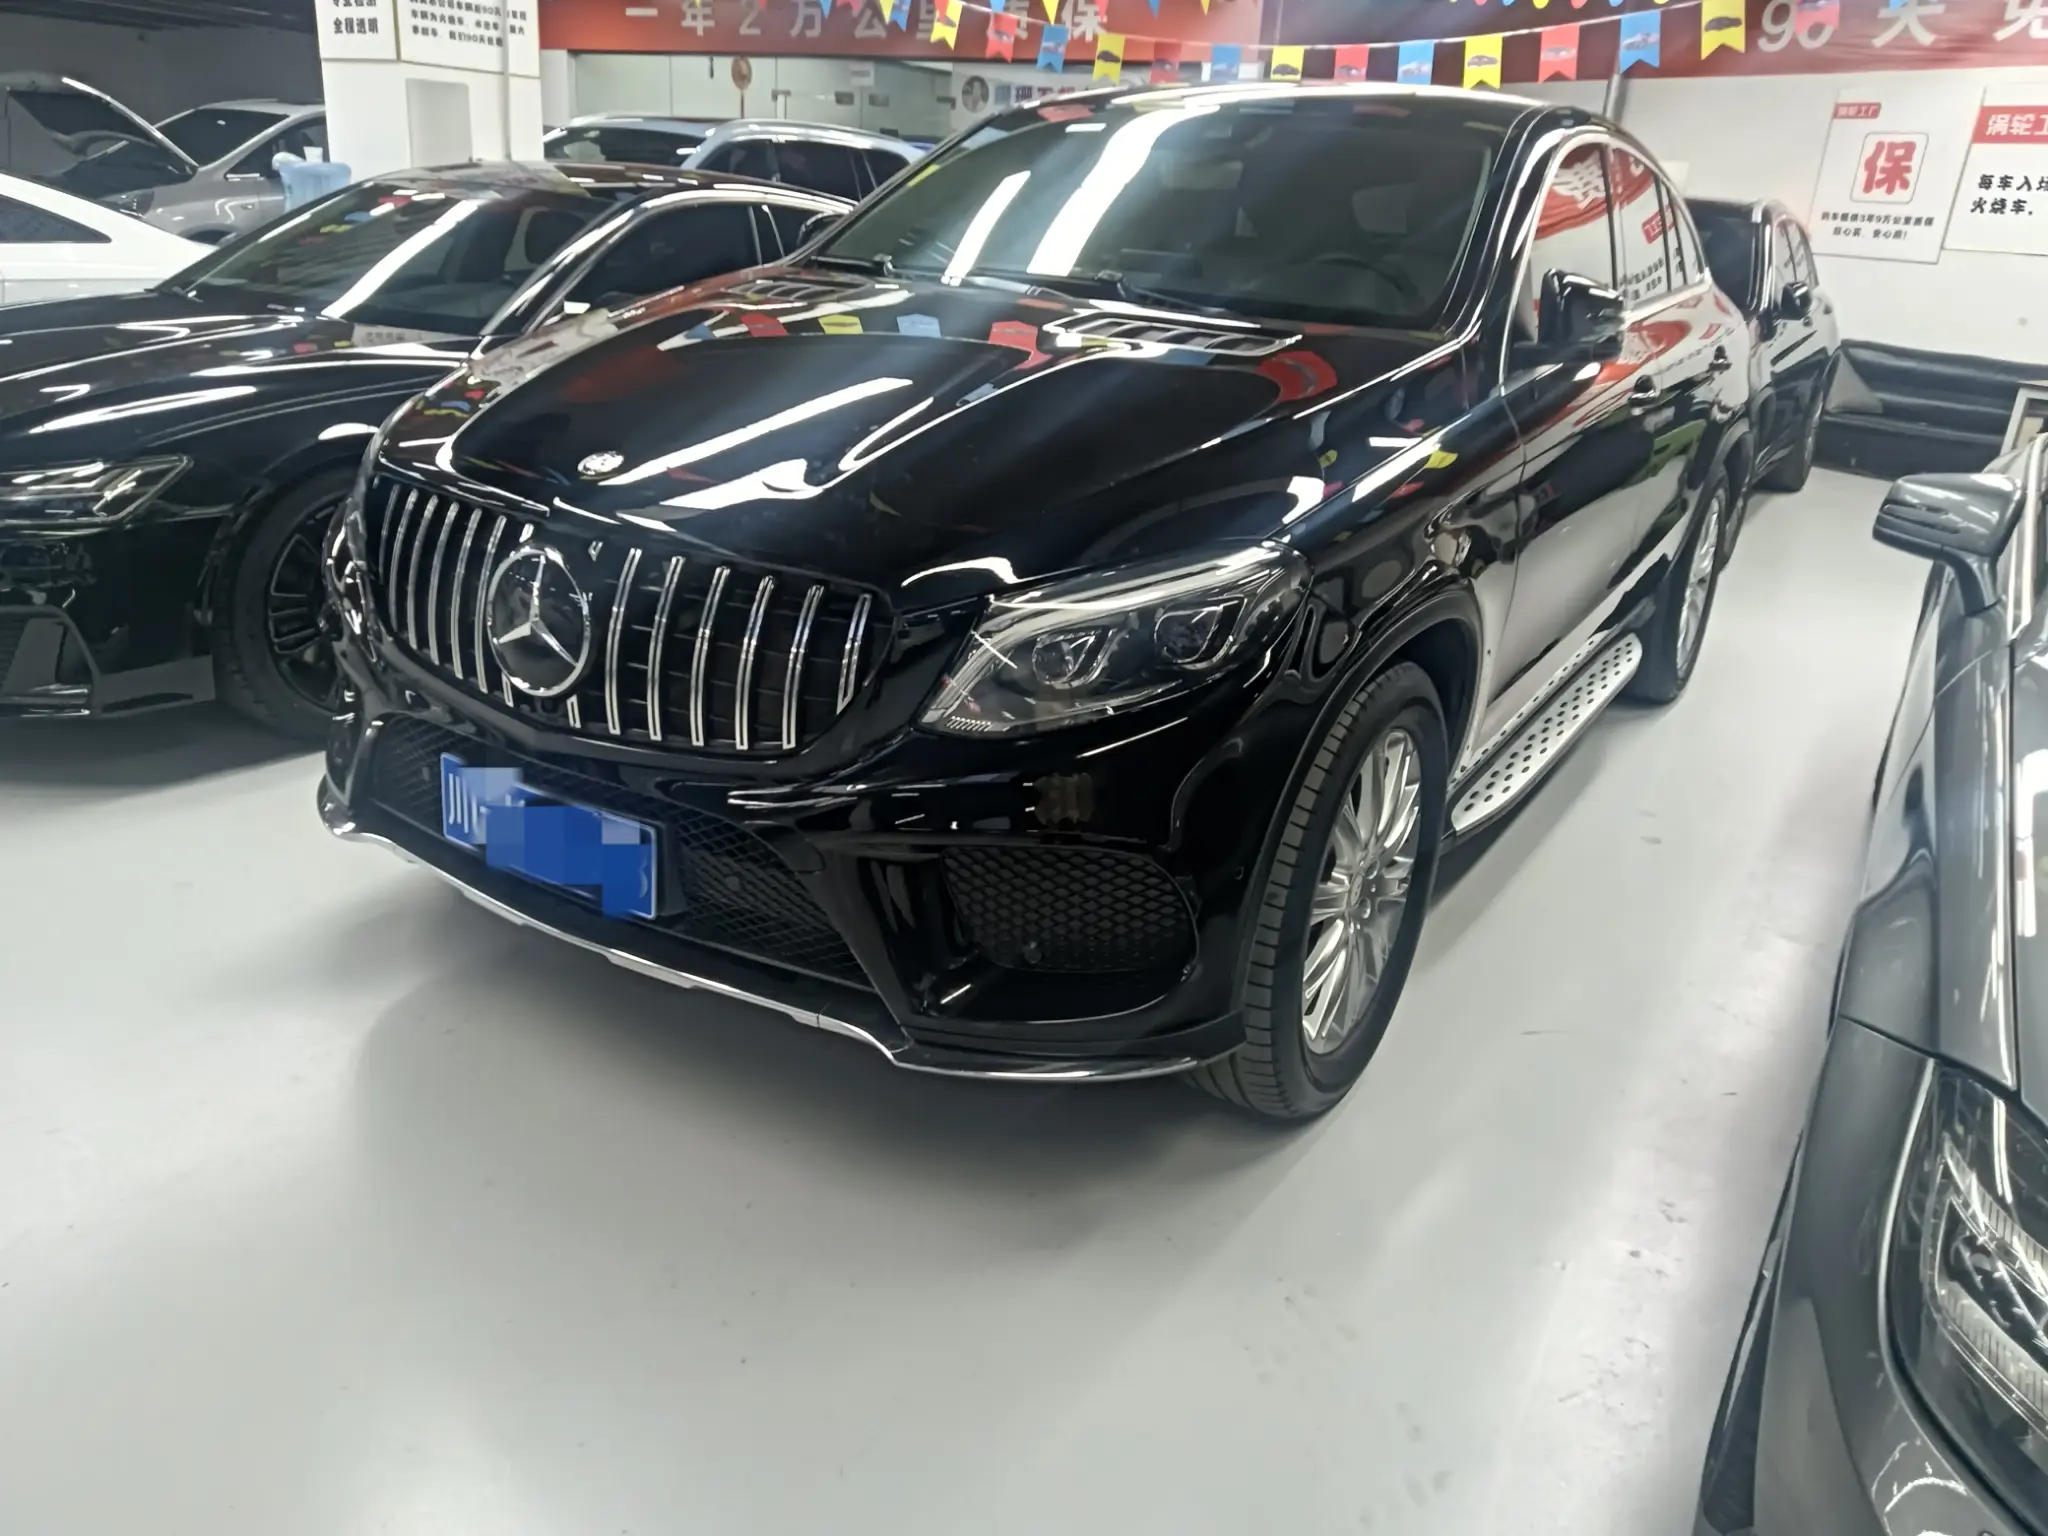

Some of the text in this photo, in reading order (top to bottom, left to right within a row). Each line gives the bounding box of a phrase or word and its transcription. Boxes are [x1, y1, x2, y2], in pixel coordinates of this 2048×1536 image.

[333, 16, 379, 35] 全程透明
[1862, 140, 1917, 196] 保
